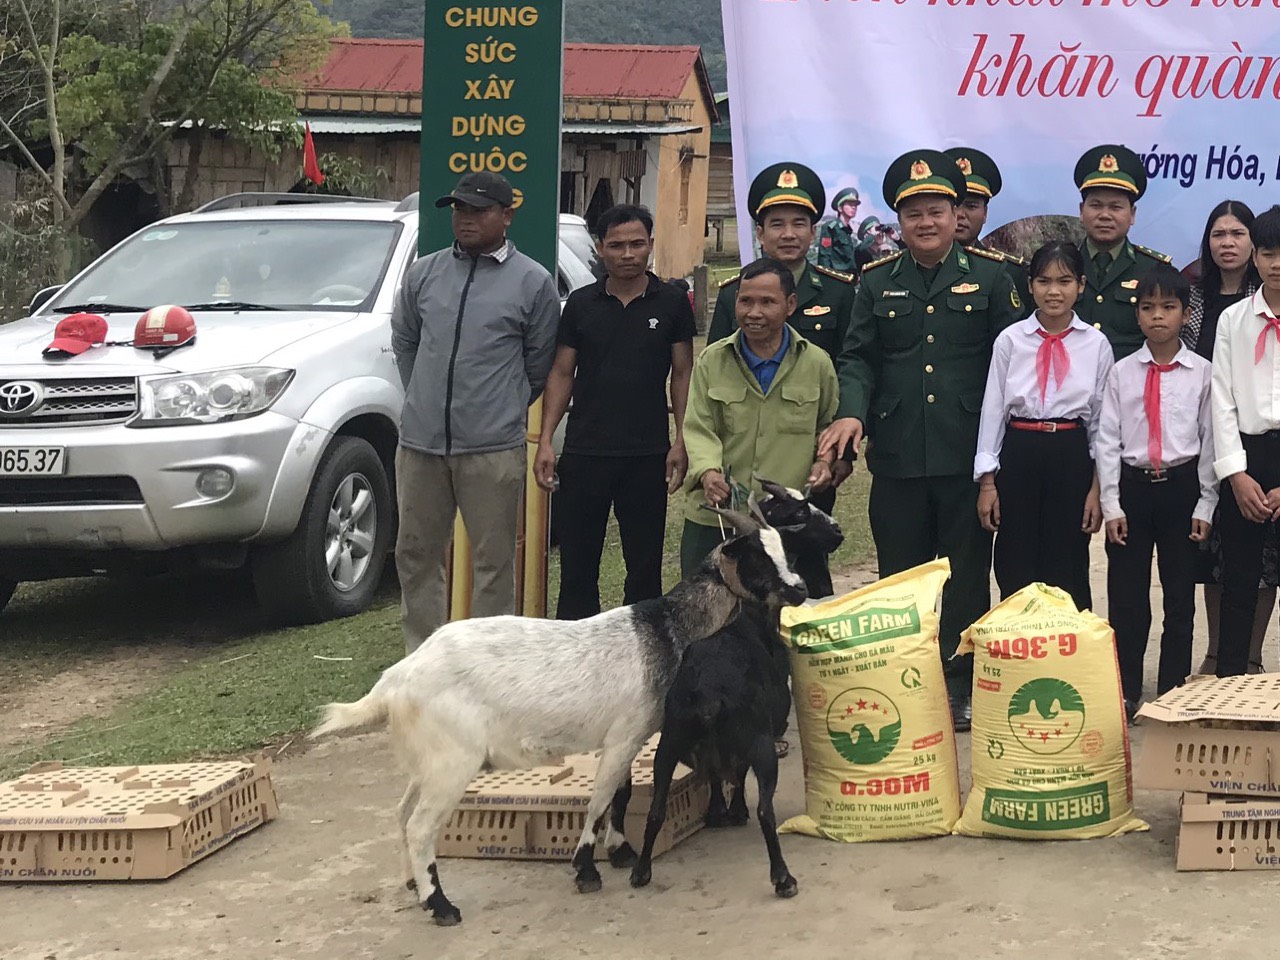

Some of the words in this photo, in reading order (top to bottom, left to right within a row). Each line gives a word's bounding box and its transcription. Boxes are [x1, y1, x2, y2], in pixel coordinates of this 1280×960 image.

[445, 6, 539, 27] CHUNG
[465, 35, 517, 63] SỨC
[957, 34, 1119, 98] khăn
[464, 74, 515, 100] XÂY
[452, 113, 526, 142] DỰNG
[1137, 144, 1197, 188] ớng
[1205, 145, 1266, 187] Hóa,
[0, 448, 61, 473] 65.37
[796, 617, 853, 647] GREEN
[858, 609, 912, 633] FARM
[986, 633, 1078, 660] G.36M
[913, 755, 925, 766] 25
[926, 753, 936, 765] kg
[835, 797, 855, 812] CÔNG
[857, 801, 867, 811] TY
[870, 800, 892, 812] TNHH
[990, 797, 1038, 822] FARM
[1045, 794, 1104, 821] GREEN
[1222, 810, 1246, 818] TRUNG
[1247, 809, 1262, 818] TÂM
[477, 846, 505, 855] VIỆN
[61, 867, 97, 877] NUÔI
